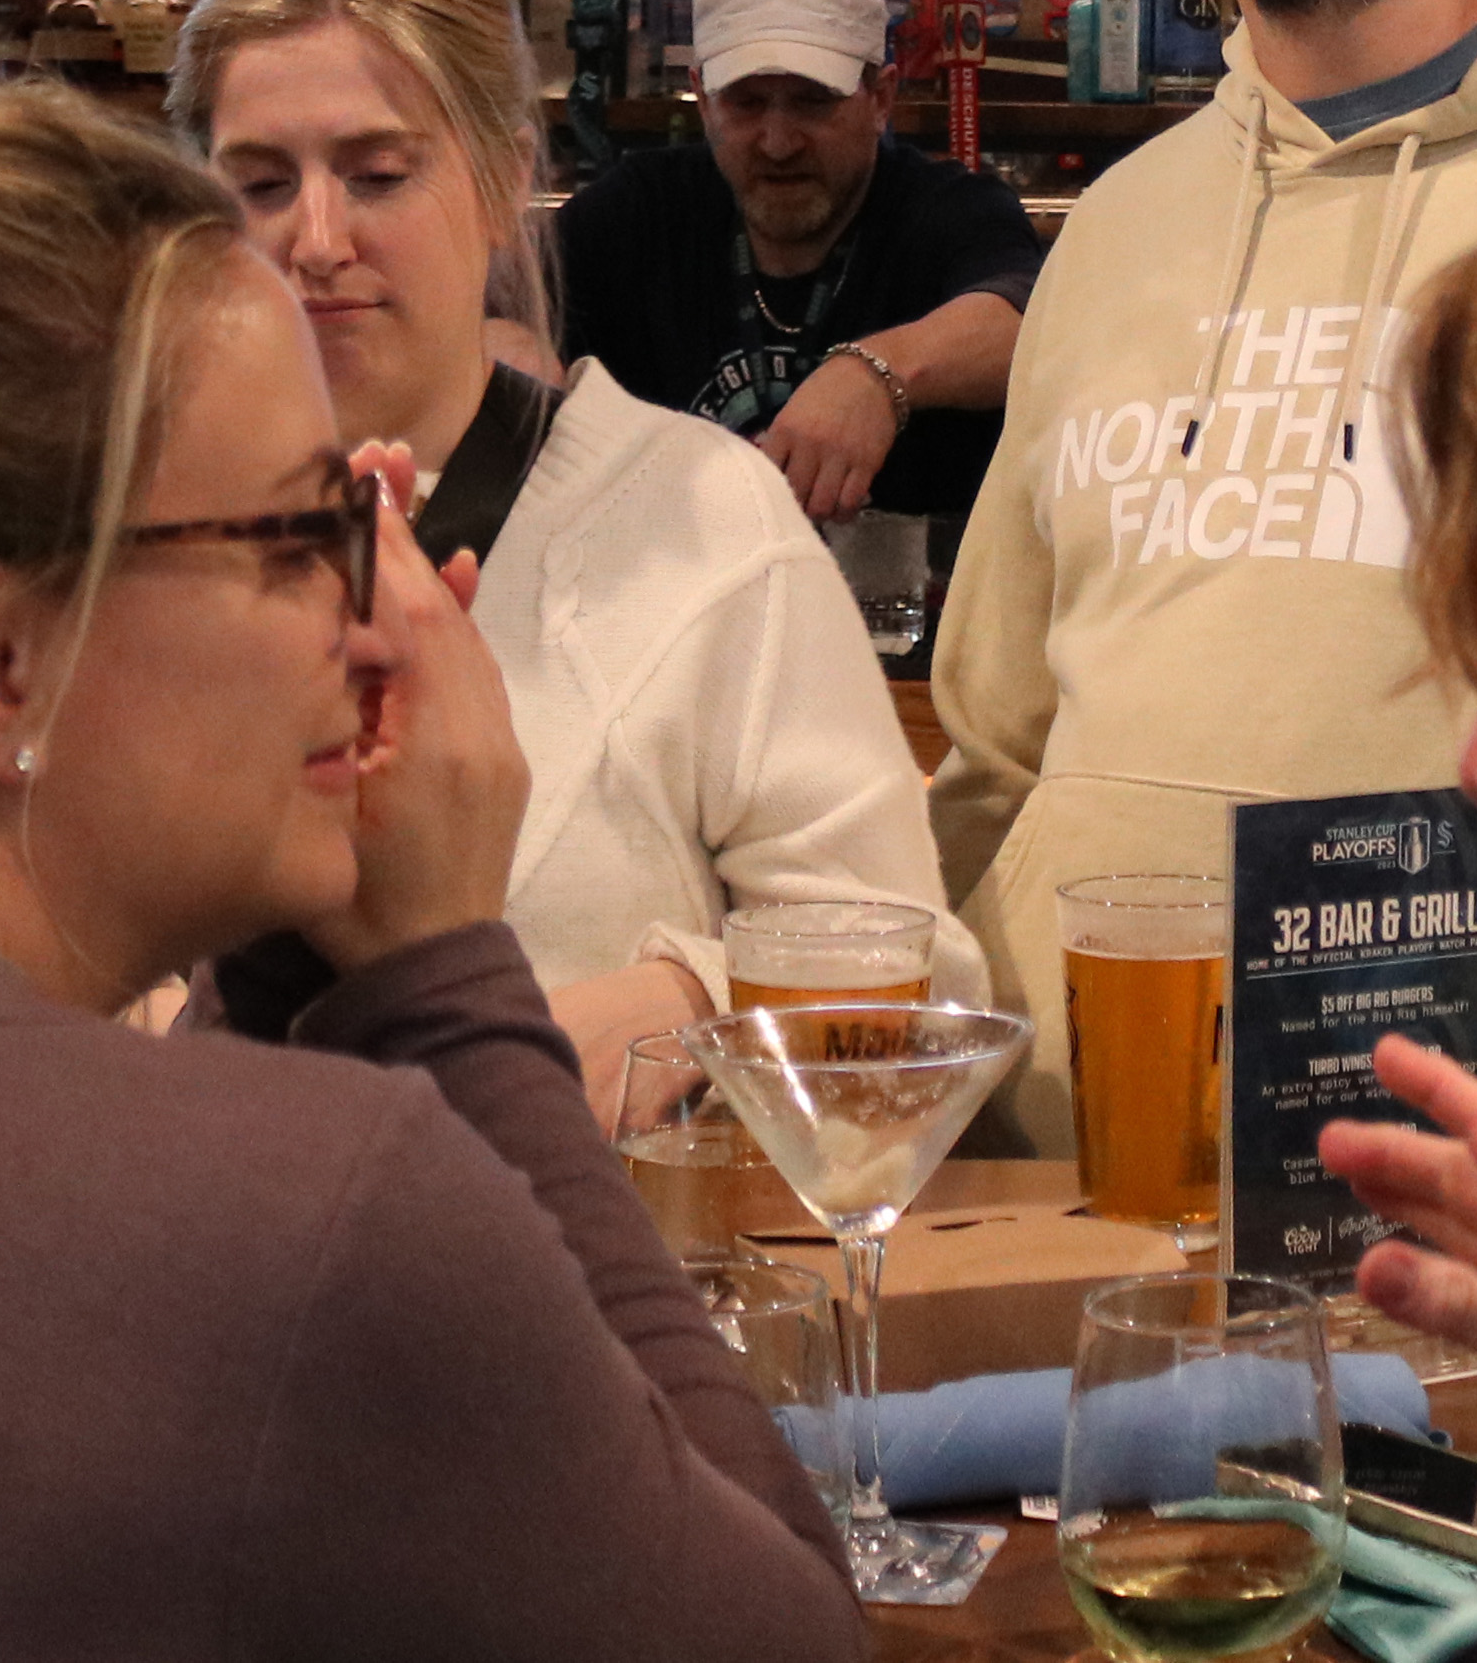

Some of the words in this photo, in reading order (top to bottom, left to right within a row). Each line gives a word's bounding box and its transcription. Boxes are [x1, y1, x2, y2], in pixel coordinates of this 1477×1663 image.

[1196, 305, 1362, 387] THE
[1054, 388, 1339, 499] NORTH
[1110, 473, 1316, 570] FACE
[1325, 824, 1374, 842] STANLEY
[1375, 822, 1397, 836] CUP
[1312, 837, 1397, 863] PLAYOFFS
[1273, 906, 1311, 954] 32
[1320, 899, 1374, 949] BAR
[1382, 896, 1402, 942] &
[1246, 958, 1269, 971] HOME
[1274, 956, 1286, 969] OF
[1291, 954, 1309, 967] THE
[1312, 950, 1355, 965] OFFICIAL
[1359, 946, 1394, 959] KRAKEN
[1397, 942, 1435, 955] PLAYOFF
[1439, 938, 1466, 951] WATCH
[1321, 996, 1335, 1015] $5
[1336, 994, 1354, 1013] OFF
[1356, 991, 1372, 1011] BIG
[1373, 989, 1390, 1008] RIG
[1391, 985, 1434, 1006] BURGERS
[1281, 1020, 1315, 1033] Named
[1322, 1015, 1340, 1028] for
[1348, 1013, 1366, 1026] the
[1372, 1010, 1392, 1025] Big
[1397, 1008, 1417, 1021] Rig
[1308, 1057, 1340, 1077] TURBO
[1341, 1053, 1372, 1073] WINGS
[1261, 1085, 1275, 1097] An
[1281, 1081, 1314, 1094] extra
[1320, 1078, 1352, 1093] spicy
[1274, 1097, 1309, 1112] named
[1315, 1093, 1333, 1106] for
[1340, 1091, 1361, 1102] our
[1289, 1171, 1317, 1186] blue
[1287, 1244, 1319, 1256] LIGHT
